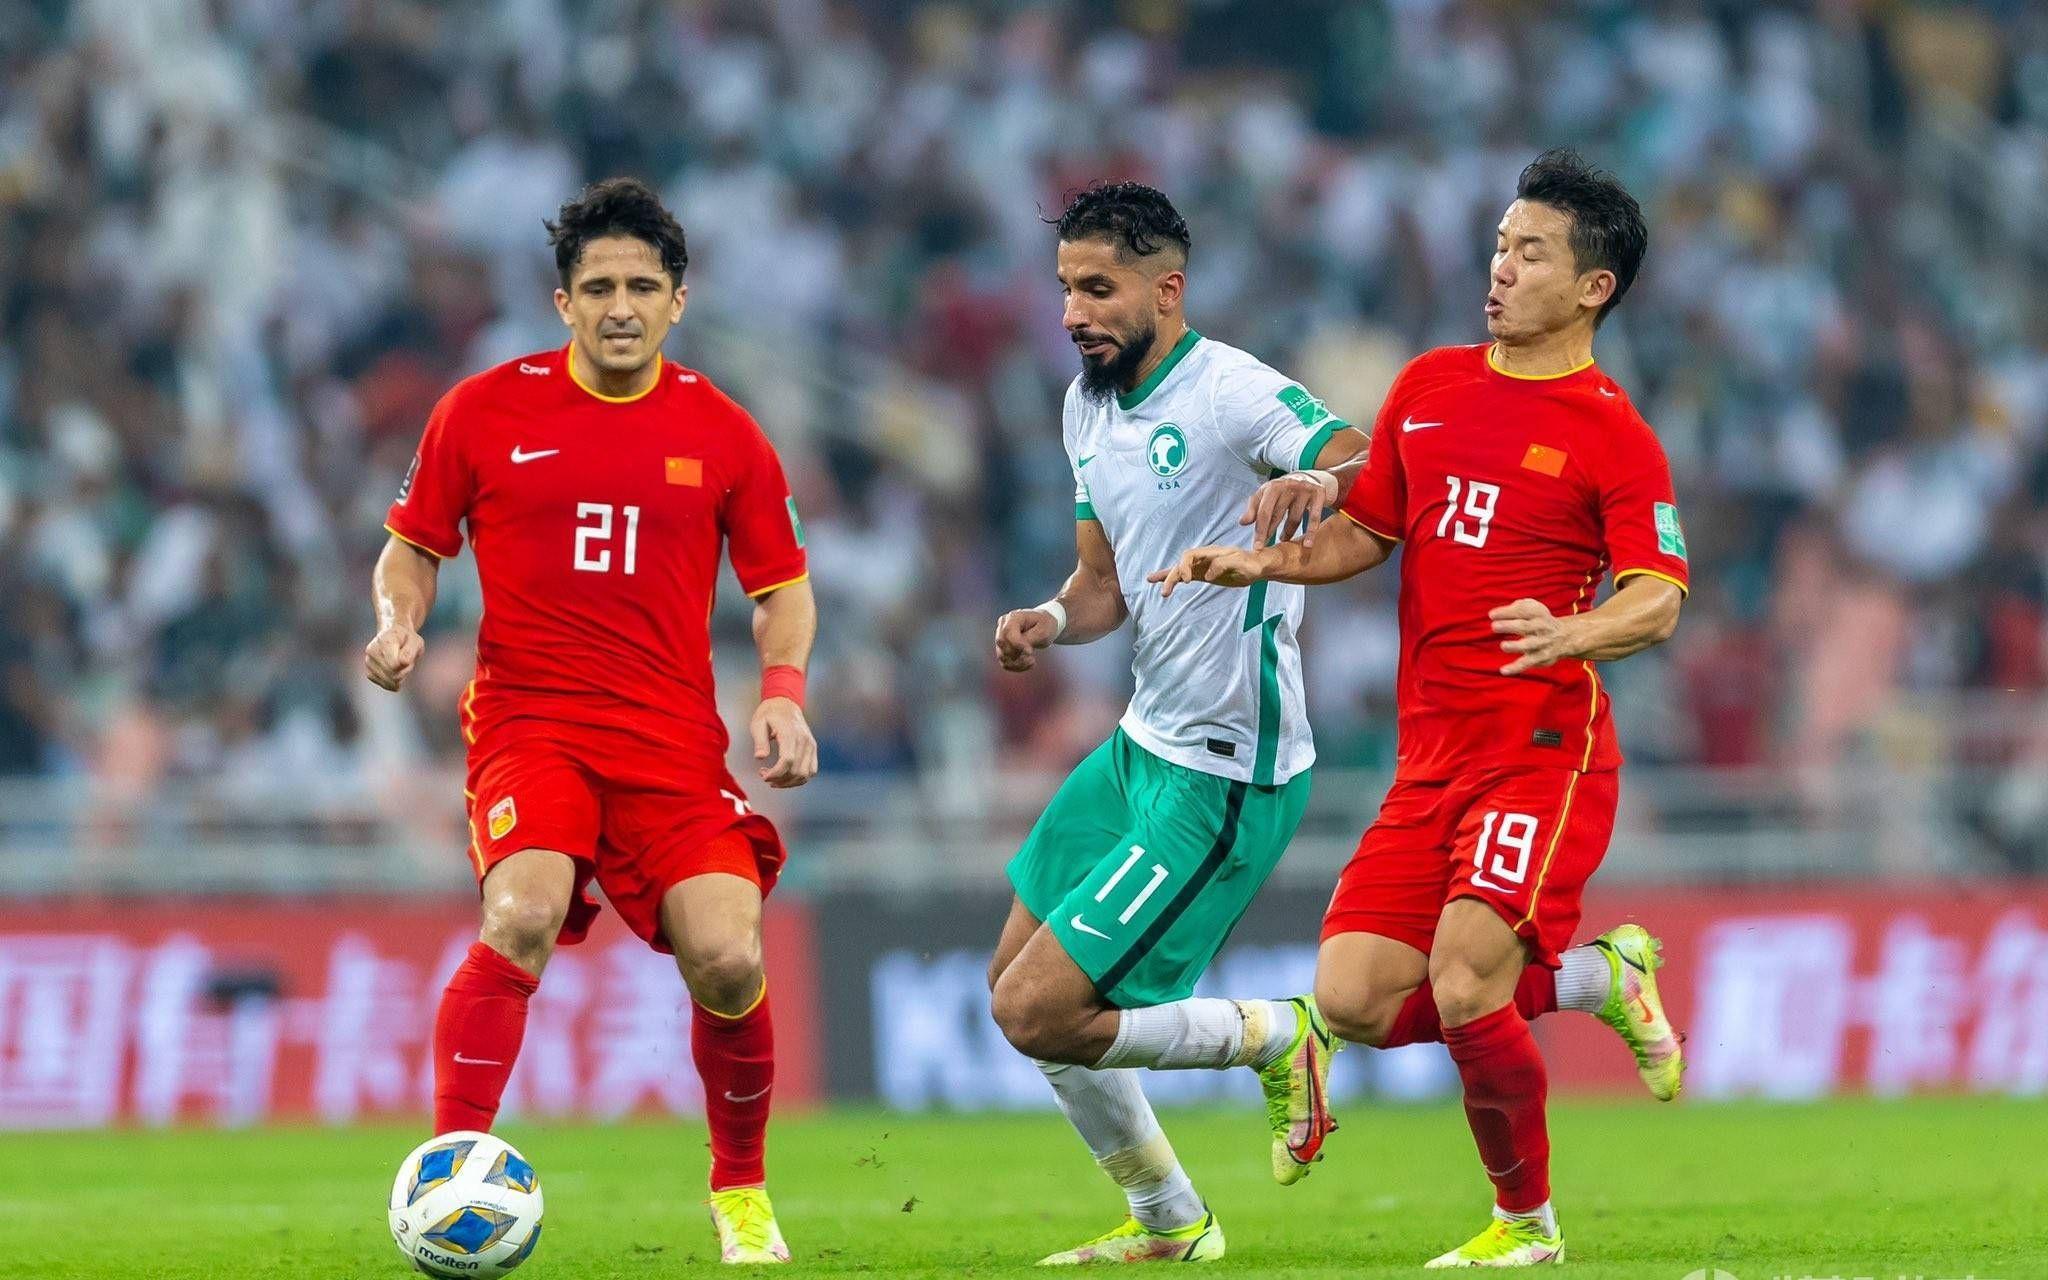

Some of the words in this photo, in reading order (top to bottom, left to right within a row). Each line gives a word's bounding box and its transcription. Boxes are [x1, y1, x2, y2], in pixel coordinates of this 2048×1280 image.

[1158, 480, 1181, 490] KSA
[1436, 475, 1501, 549] 19
[573, 502, 641, 575] 21
[1473, 811, 1539, 884] 19
[1094, 844, 1170, 926] 11
[418, 1246, 479, 1270] molten
